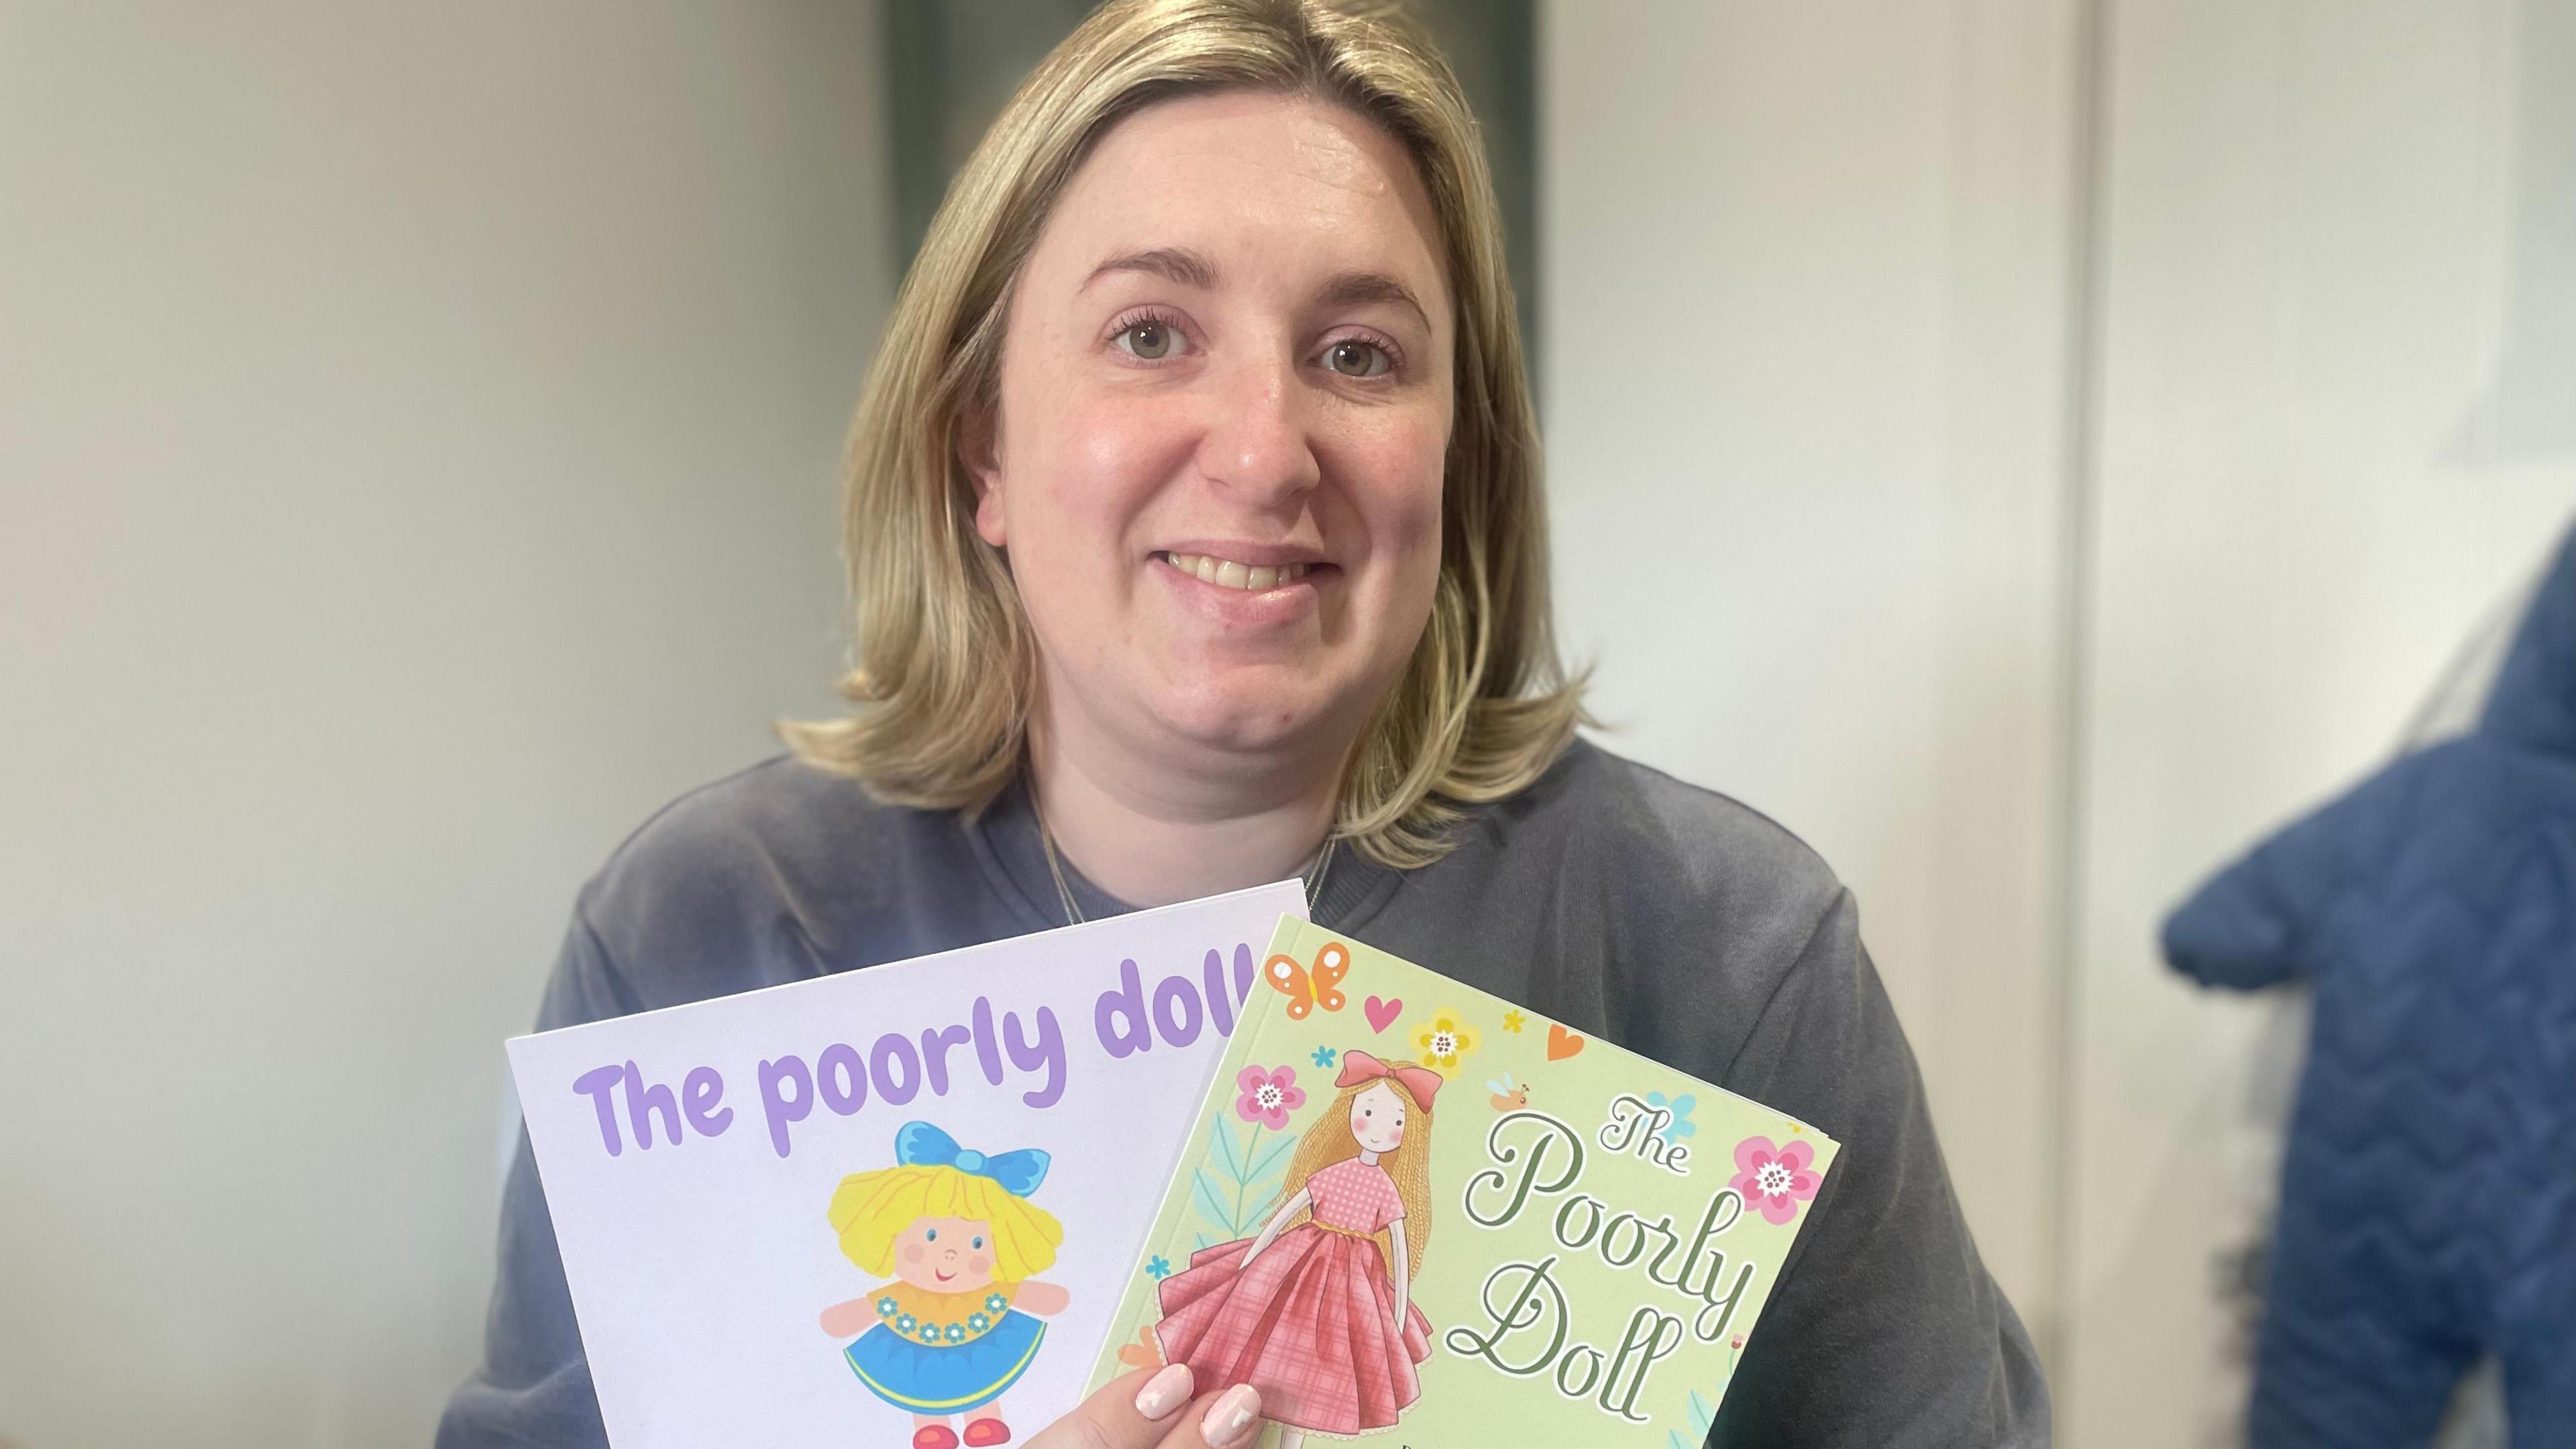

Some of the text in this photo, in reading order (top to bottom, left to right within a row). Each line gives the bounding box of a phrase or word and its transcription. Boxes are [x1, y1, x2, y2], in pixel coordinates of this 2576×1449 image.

[573, 1059, 734, 1157] The
[757, 996, 1067, 1158] poorly
[1601, 1096, 1688, 1174] The
[1464, 1112, 1754, 1342] Poorly
[1445, 1256, 1683, 1421] Doll
